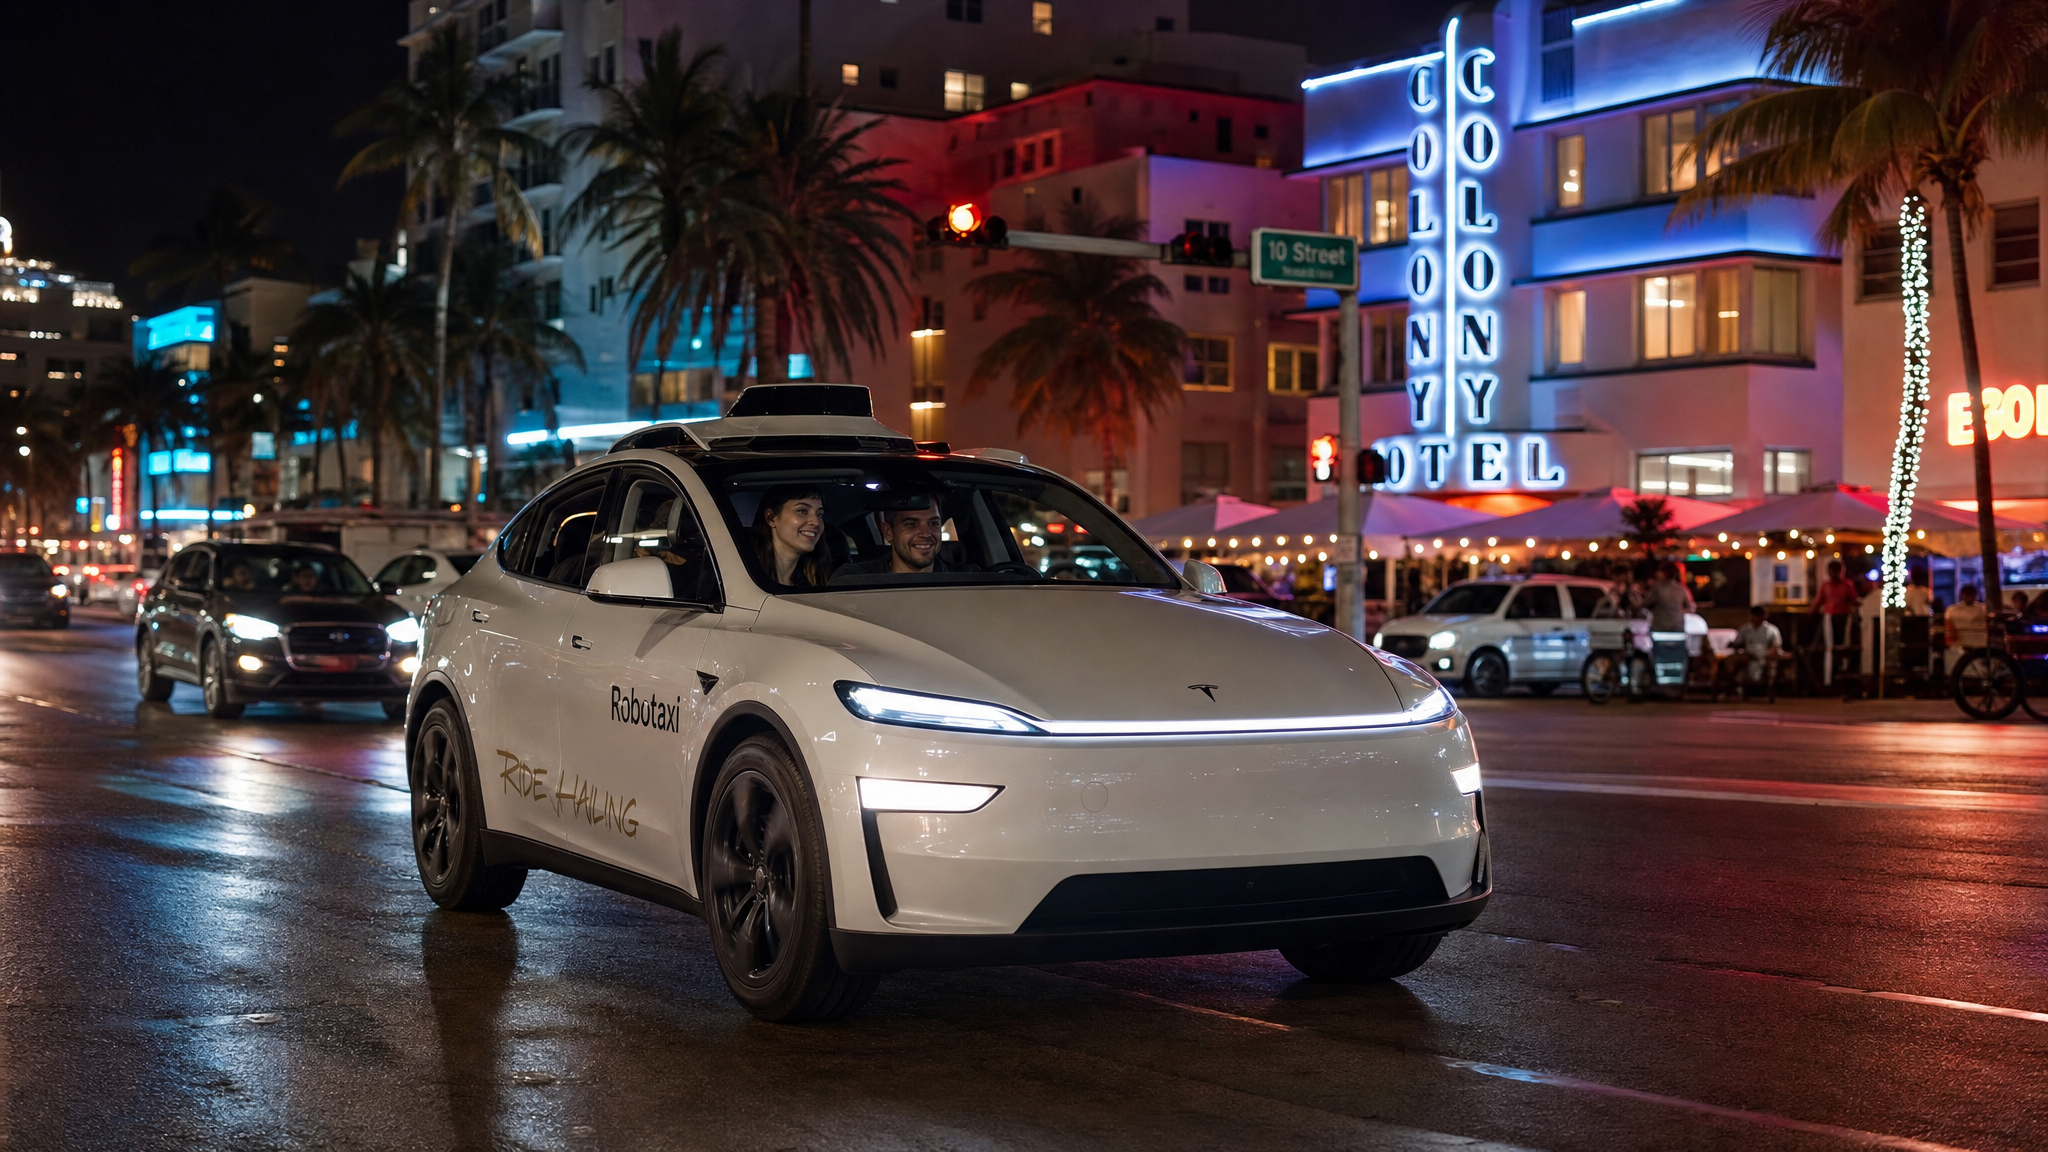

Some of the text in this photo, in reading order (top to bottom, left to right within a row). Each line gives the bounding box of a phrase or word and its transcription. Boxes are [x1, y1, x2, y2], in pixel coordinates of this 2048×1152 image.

[1268, 239, 1347, 266] 10 Street
[1406, 61, 1441, 428] COLONY
[1456, 47, 1500, 425] COLONY
[1371, 435, 1565, 490] OTEL
[611, 685, 681, 733] Robotaxi
[496, 749, 640, 840] RIDE HAILING
